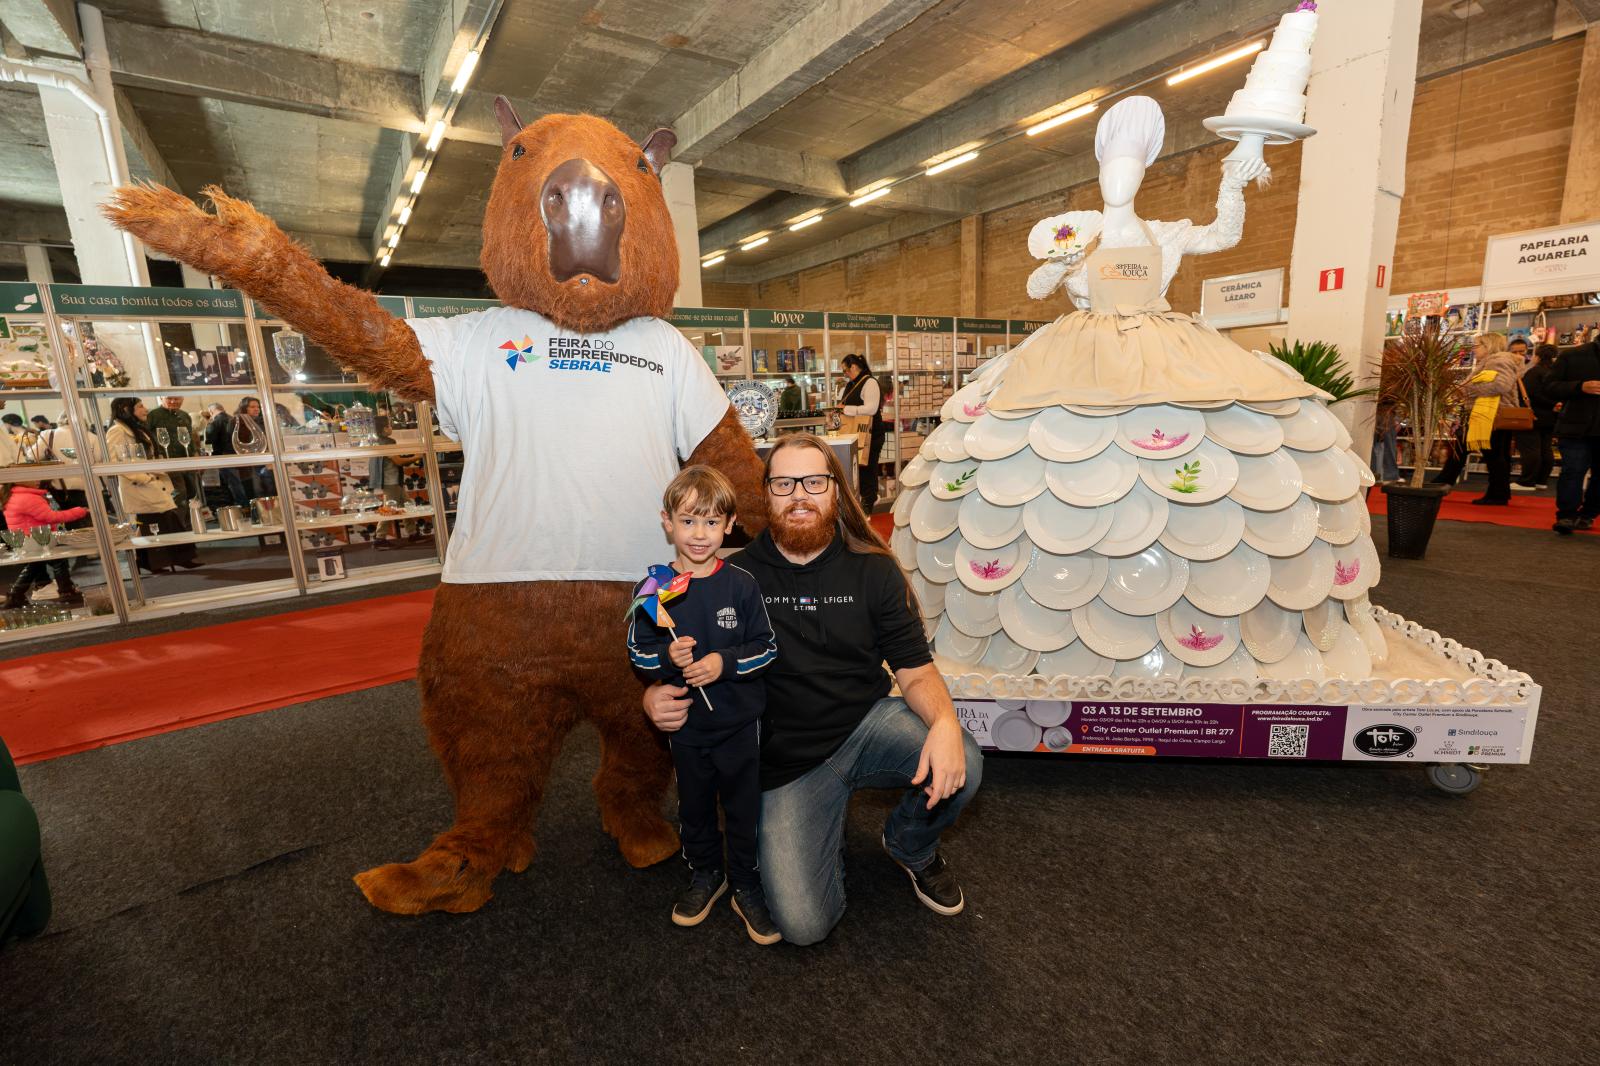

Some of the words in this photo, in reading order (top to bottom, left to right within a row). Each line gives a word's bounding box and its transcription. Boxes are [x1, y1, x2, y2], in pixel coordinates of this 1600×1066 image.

[1520, 234, 1590, 251] PAPELARIA
[1517, 247, 1588, 264] AQUARELA
[60, 294, 86, 305] Sua
[89, 296, 118, 306] casa
[121, 295, 159, 307] bonita
[162, 297, 194, 308] todos
[196, 300, 210, 308] os
[212, 298, 238, 309] dias!
[1224, 291, 1256, 302] LÁZARO
[437, 304, 460, 314] estilo
[548, 338, 591, 349] FEIRA
[594, 339, 615, 351] DO
[548, 348, 664, 376] EMPREENDEDOR
[548, 359, 613, 373] SEBRAE
[765, 596, 797, 604] OMMY
[813, 595, 854, 604] HLFIGER
[956, 707, 976, 719] IRA
[1082, 706, 1097, 715] 03
[1098, 706, 1107, 715] A
[1109, 706, 1120, 715] 13
[1123, 706, 1139, 715] DE
[1140, 707, 1203, 717] SETEMBRO
[1251, 709, 1297, 717] PROGRAMAÇÃO
[1092, 725, 1109, 735] City
[1110, 726, 1137, 734] Center
[1138, 726, 1162, 734] Outlet
[1164, 727, 1199, 735] Premium
[1218, 728, 1234, 736] 277
[1458, 728, 1498, 737] Sindilouça
